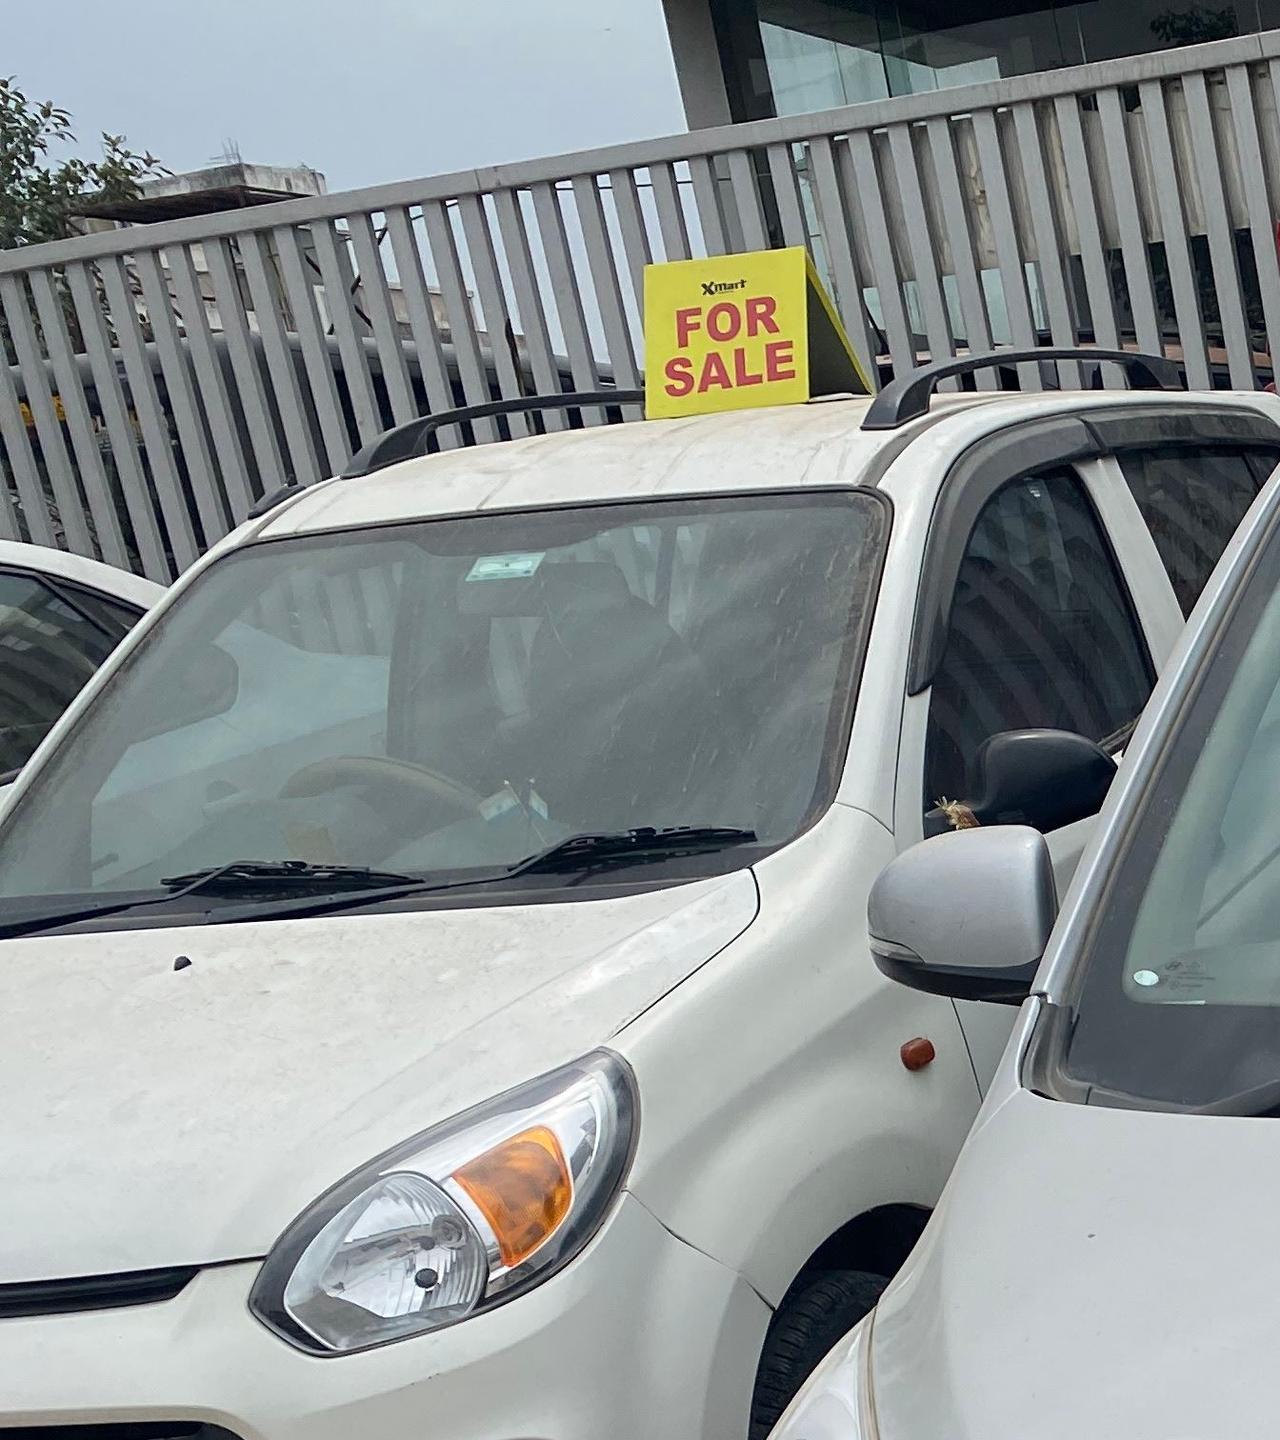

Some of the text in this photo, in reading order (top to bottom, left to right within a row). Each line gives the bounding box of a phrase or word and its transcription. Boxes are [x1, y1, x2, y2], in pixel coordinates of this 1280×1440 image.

[700, 279, 747, 295] Xmart
[675, 296, 780, 348] FOR
[664, 340, 796, 397] SALE
